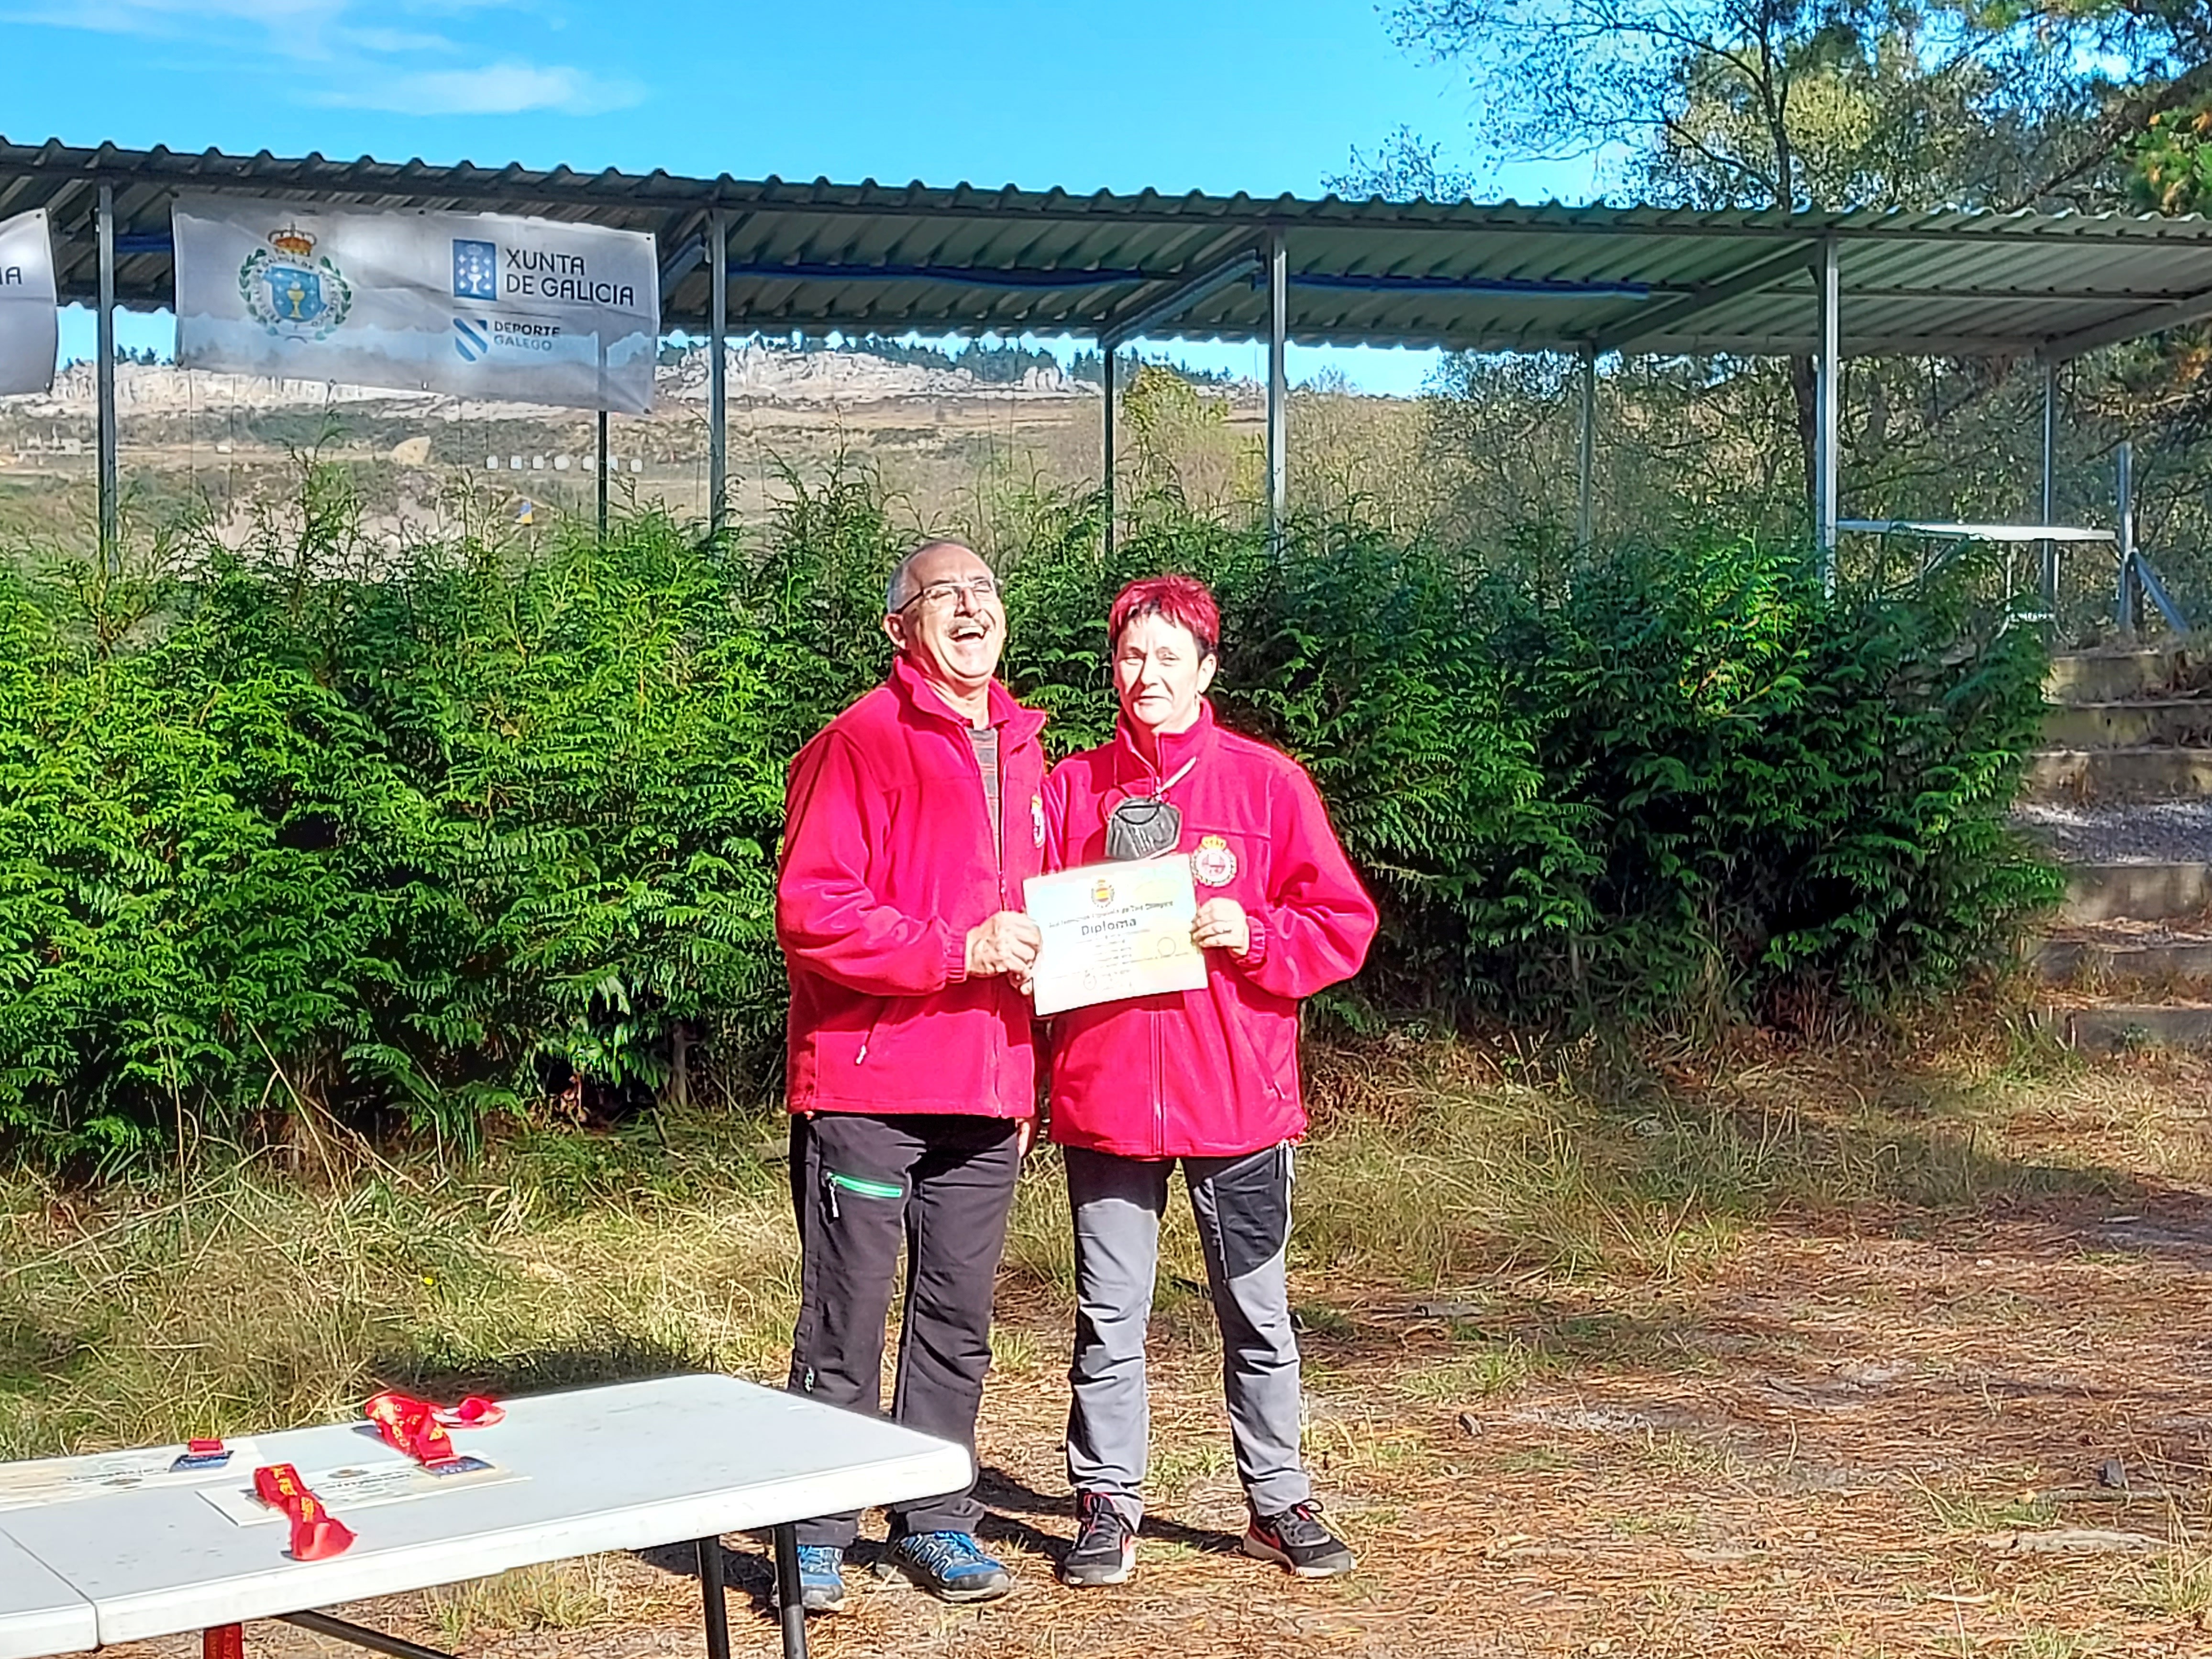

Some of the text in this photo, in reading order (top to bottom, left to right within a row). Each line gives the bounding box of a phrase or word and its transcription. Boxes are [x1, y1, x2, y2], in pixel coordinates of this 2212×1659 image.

[506, 249, 585, 276] XUNTA
[506, 274, 634, 306] DE GALICIA
[494, 320, 560, 336] DEPORTE
[494, 335, 552, 351] GALEGO
[1081, 918, 1137, 936] Diploma
